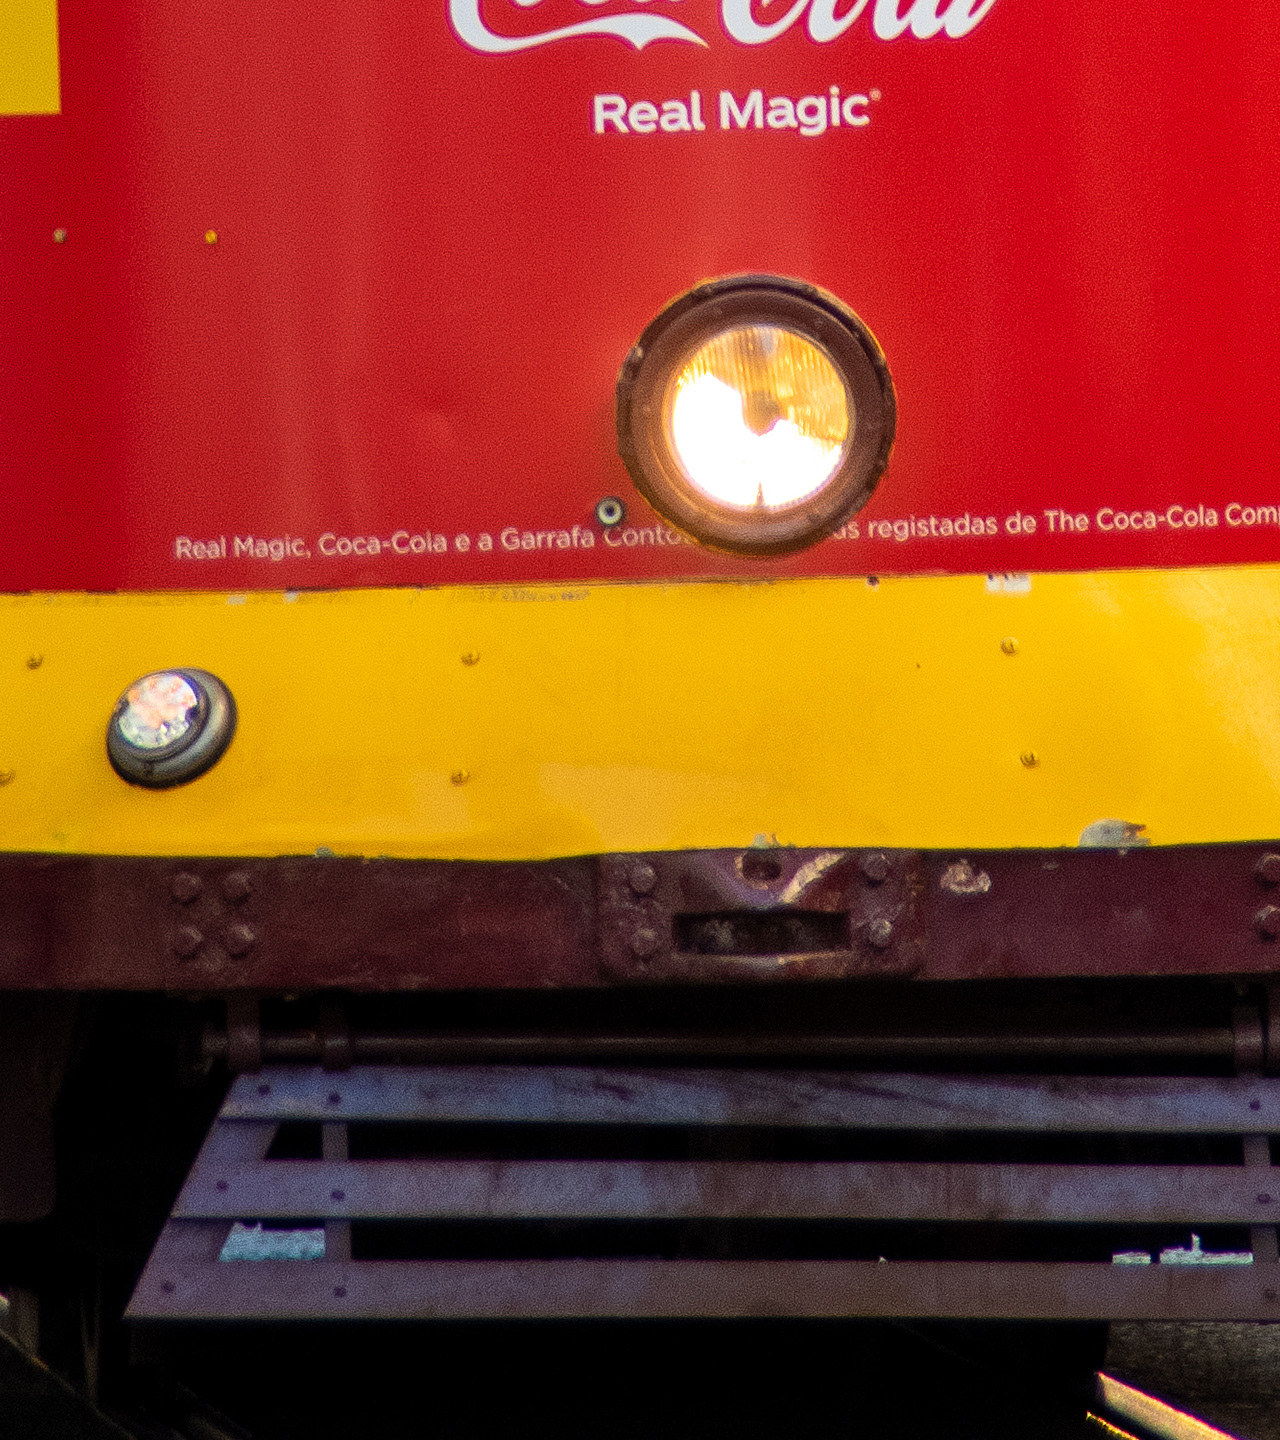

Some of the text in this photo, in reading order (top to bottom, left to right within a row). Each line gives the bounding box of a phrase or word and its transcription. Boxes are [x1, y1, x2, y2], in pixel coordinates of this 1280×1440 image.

[593, 91, 706, 134] Real
[175, 534, 227, 560] Real
[233, 533, 312, 562] Magic,
[318, 529, 448, 557] Coca-Cola
[455, 532, 471, 553] e
[477, 532, 494, 552] a
[500, 524, 596, 552] Garrafa
[867, 512, 998, 542] registadas
[1004, 511, 1037, 534] de
[1042, 509, 1090, 534] The
[1095, 503, 1219, 532] Coca-Cola
